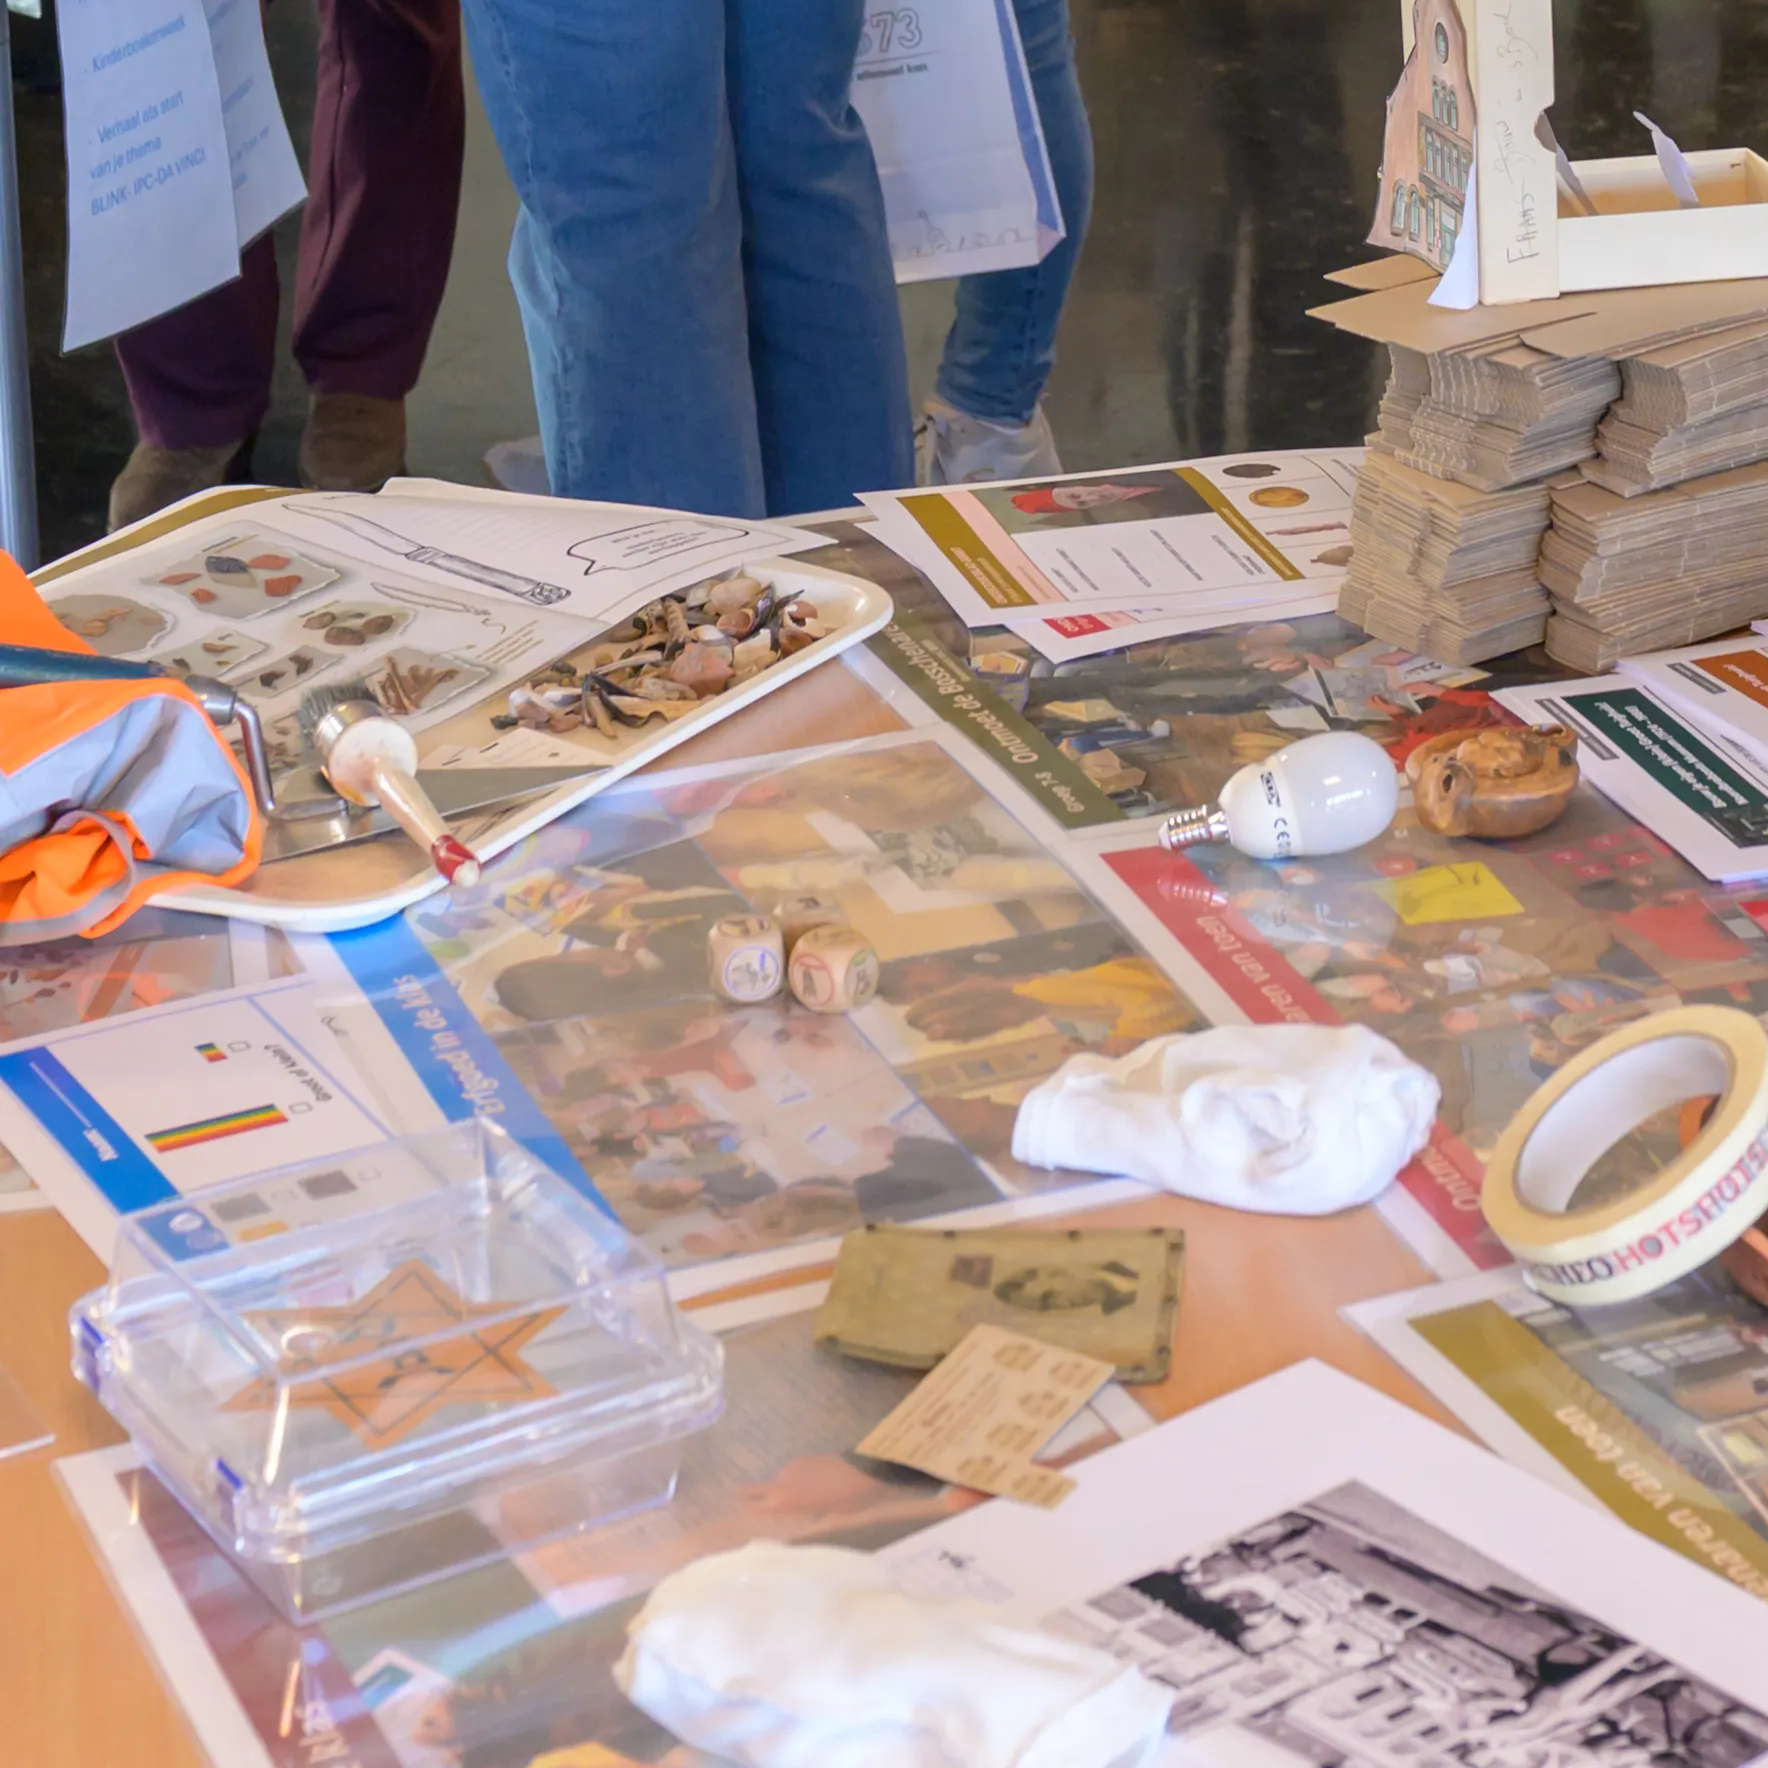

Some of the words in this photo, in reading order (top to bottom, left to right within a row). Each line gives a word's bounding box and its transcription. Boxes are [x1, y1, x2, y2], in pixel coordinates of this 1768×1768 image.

[952, 691, 982, 714] de
[966, 706, 1039, 765] Ontmoet
[1195, 916, 1242, 951] toen
[1231, 950, 1271, 982] van
[413, 1006, 448, 1028] de
[431, 1029, 461, 1050] in
[436, 1050, 506, 1117] Erfgoed
[1552, 1403, 1626, 1460] toen
[1613, 1460, 1676, 1510] van
